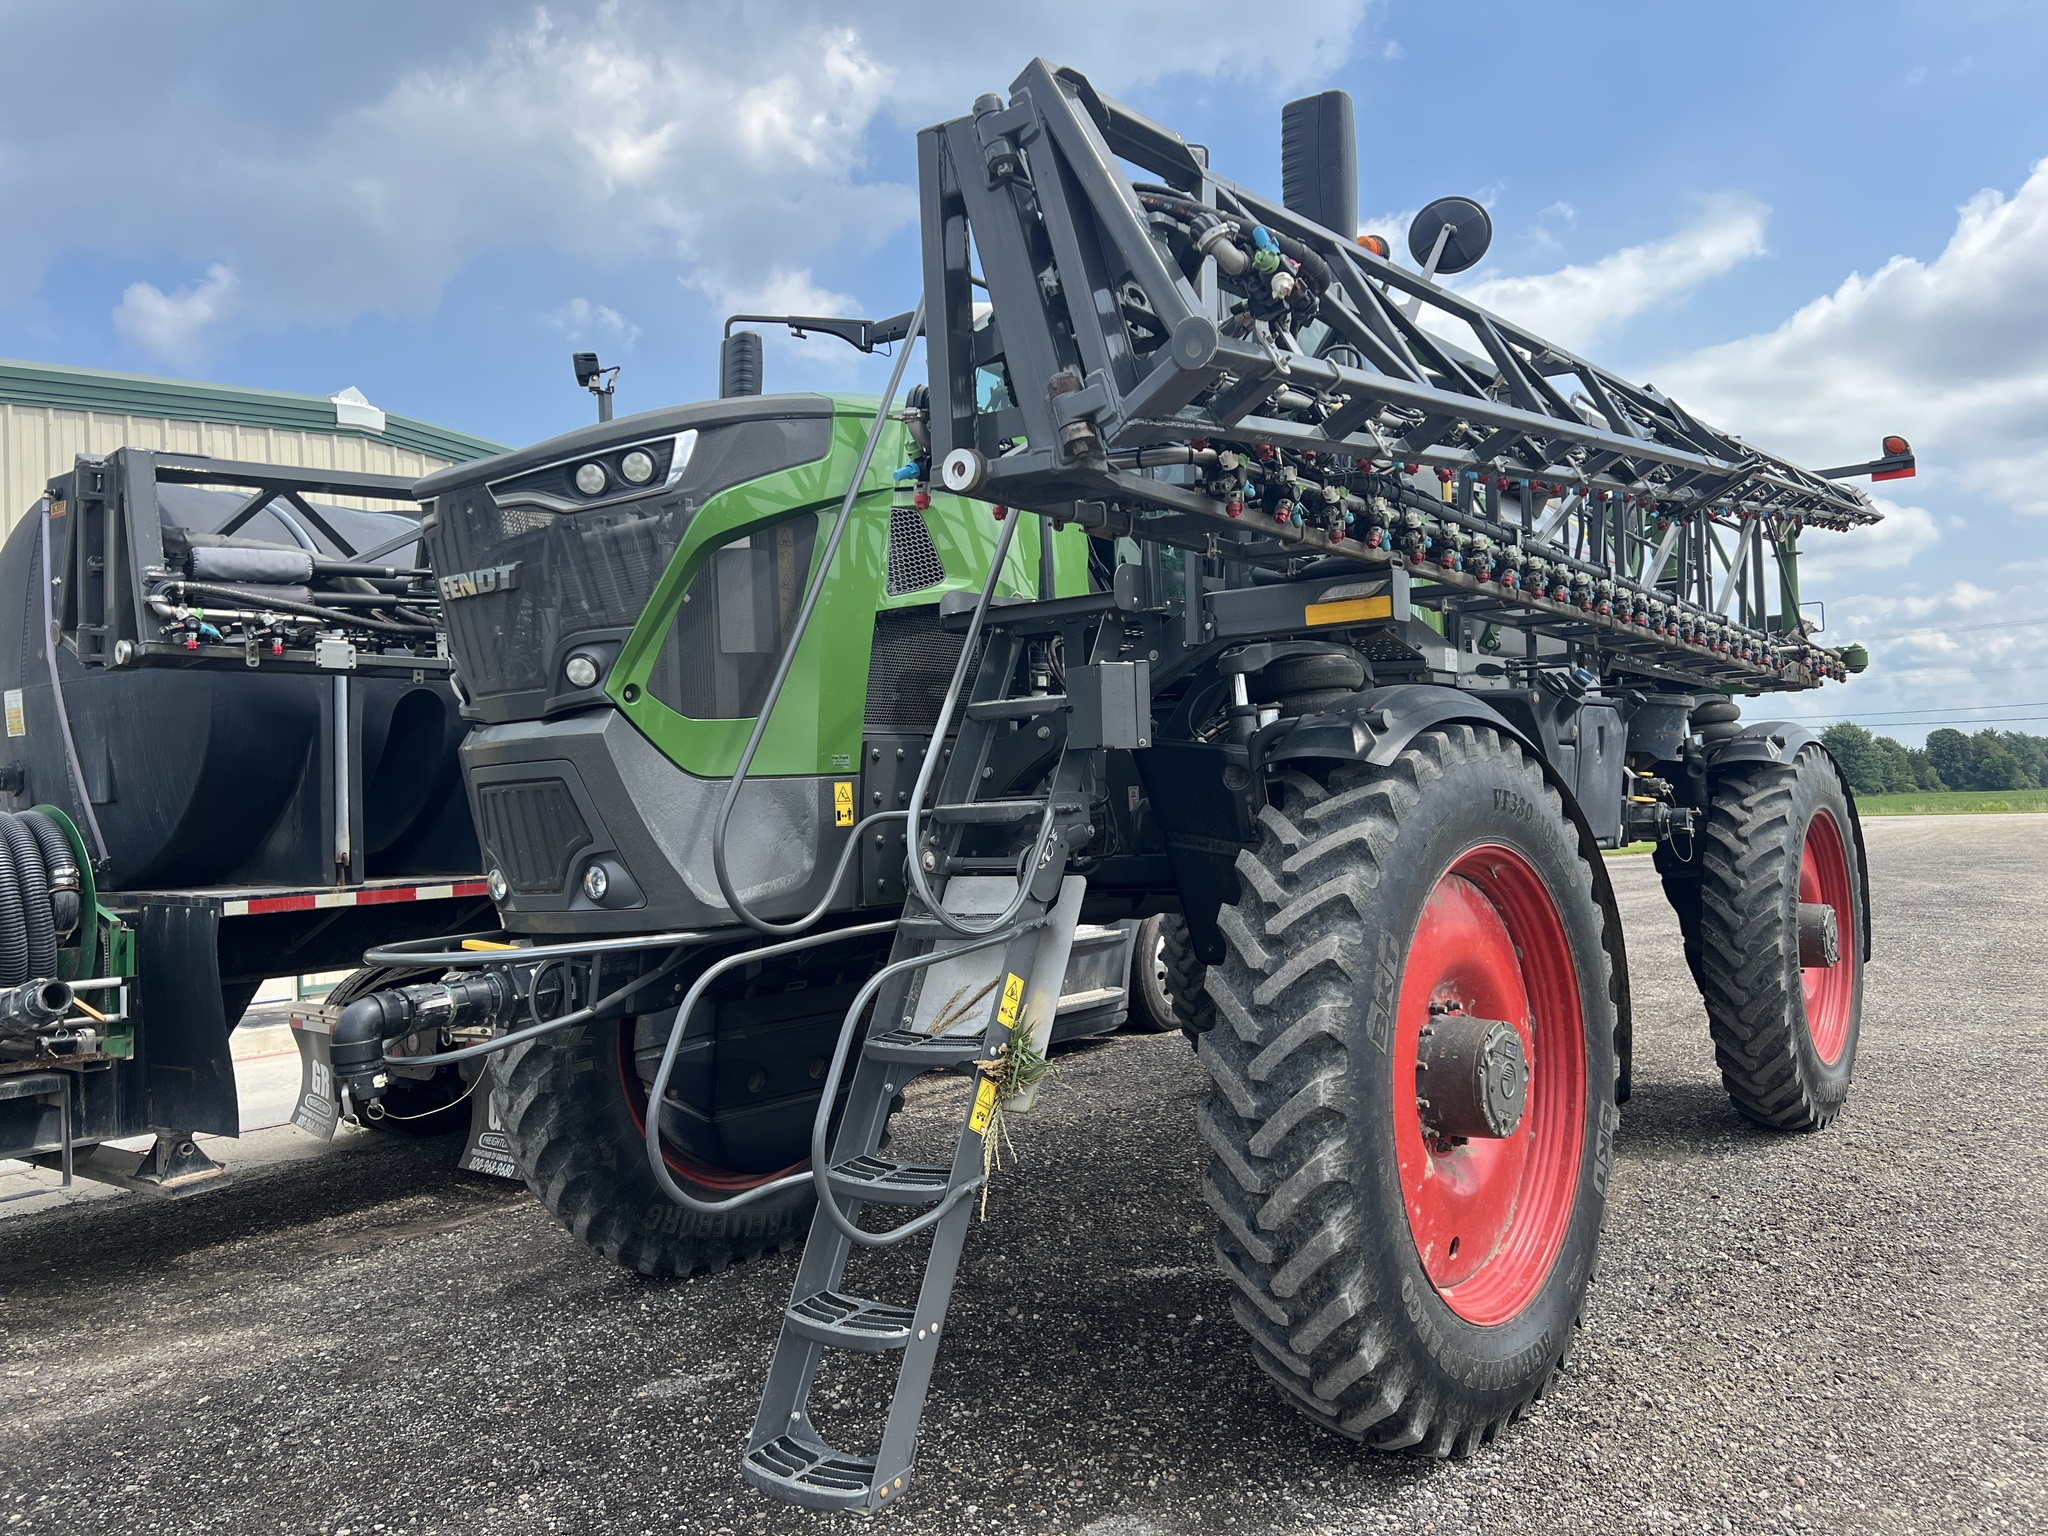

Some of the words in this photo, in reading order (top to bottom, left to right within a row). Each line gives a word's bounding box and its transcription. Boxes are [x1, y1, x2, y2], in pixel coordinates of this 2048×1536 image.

[438, 561, 521, 601] FENDT
[1366, 925, 1400, 1056] BKT
[311, 1059, 330, 1099] GR
[482, 1135, 508, 1148] FREIGHTL
[1593, 1099, 1613, 1200] BKT
[469, 1156, 515, 1178] 800-968-9680
